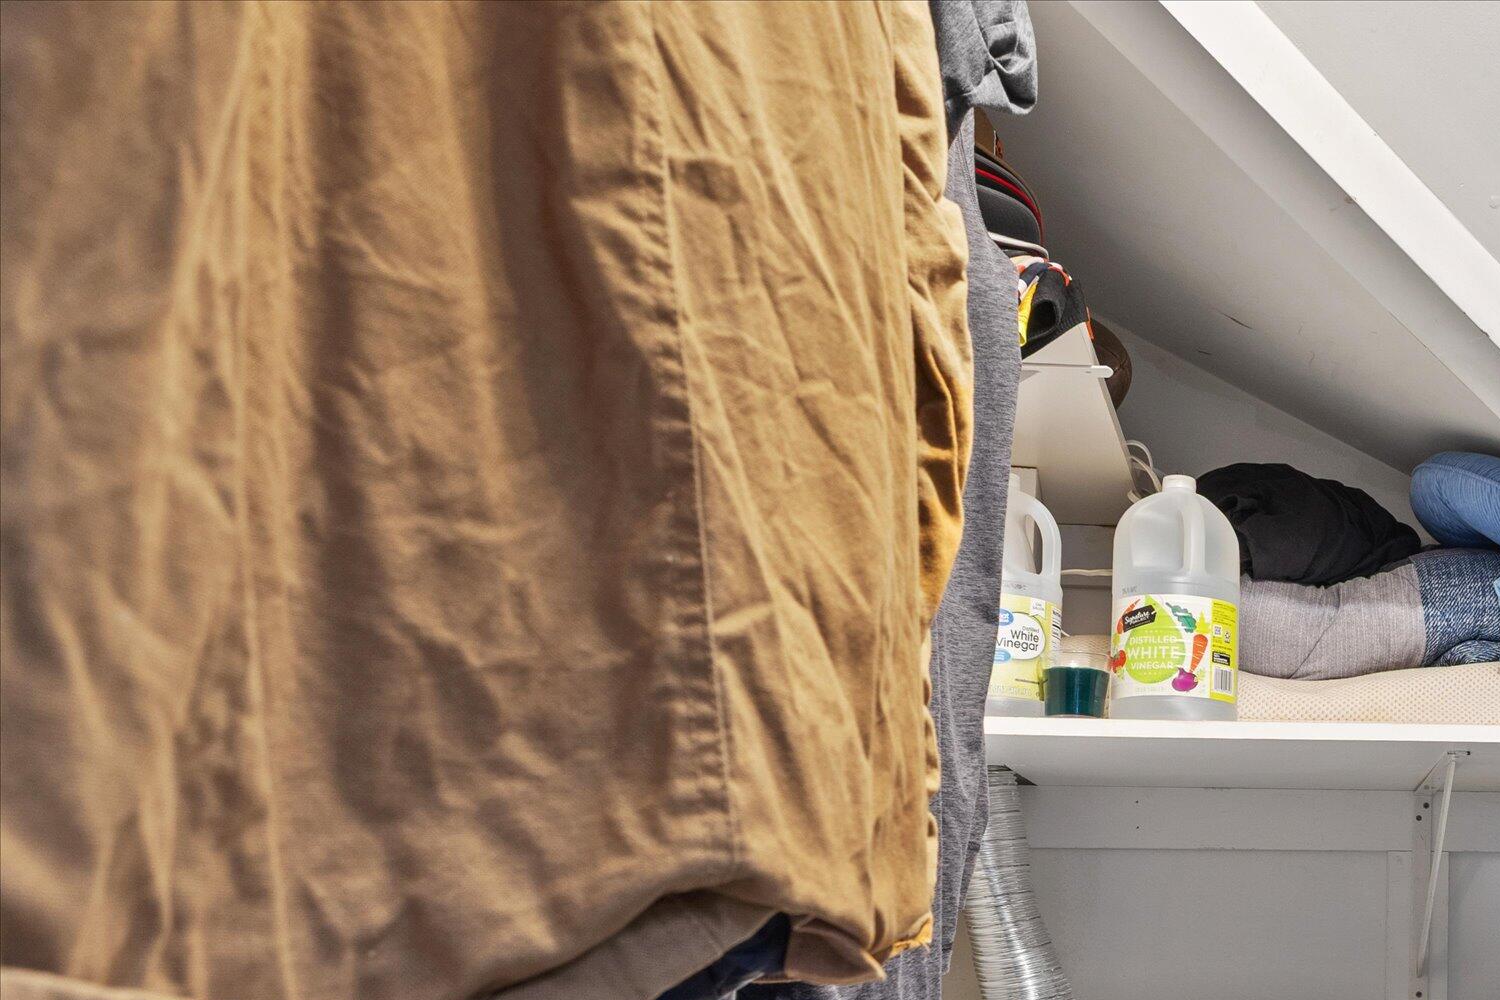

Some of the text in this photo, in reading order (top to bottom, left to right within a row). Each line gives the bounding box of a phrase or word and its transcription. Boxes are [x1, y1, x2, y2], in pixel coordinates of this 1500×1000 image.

[1010, 630, 1040, 643] White
[1129, 636, 1177, 645] DISTILLED
[995, 637, 1039, 652] Vinegar
[1127, 645, 1181, 659] WHITE
[1131, 661, 1175, 670] VINEGAR
